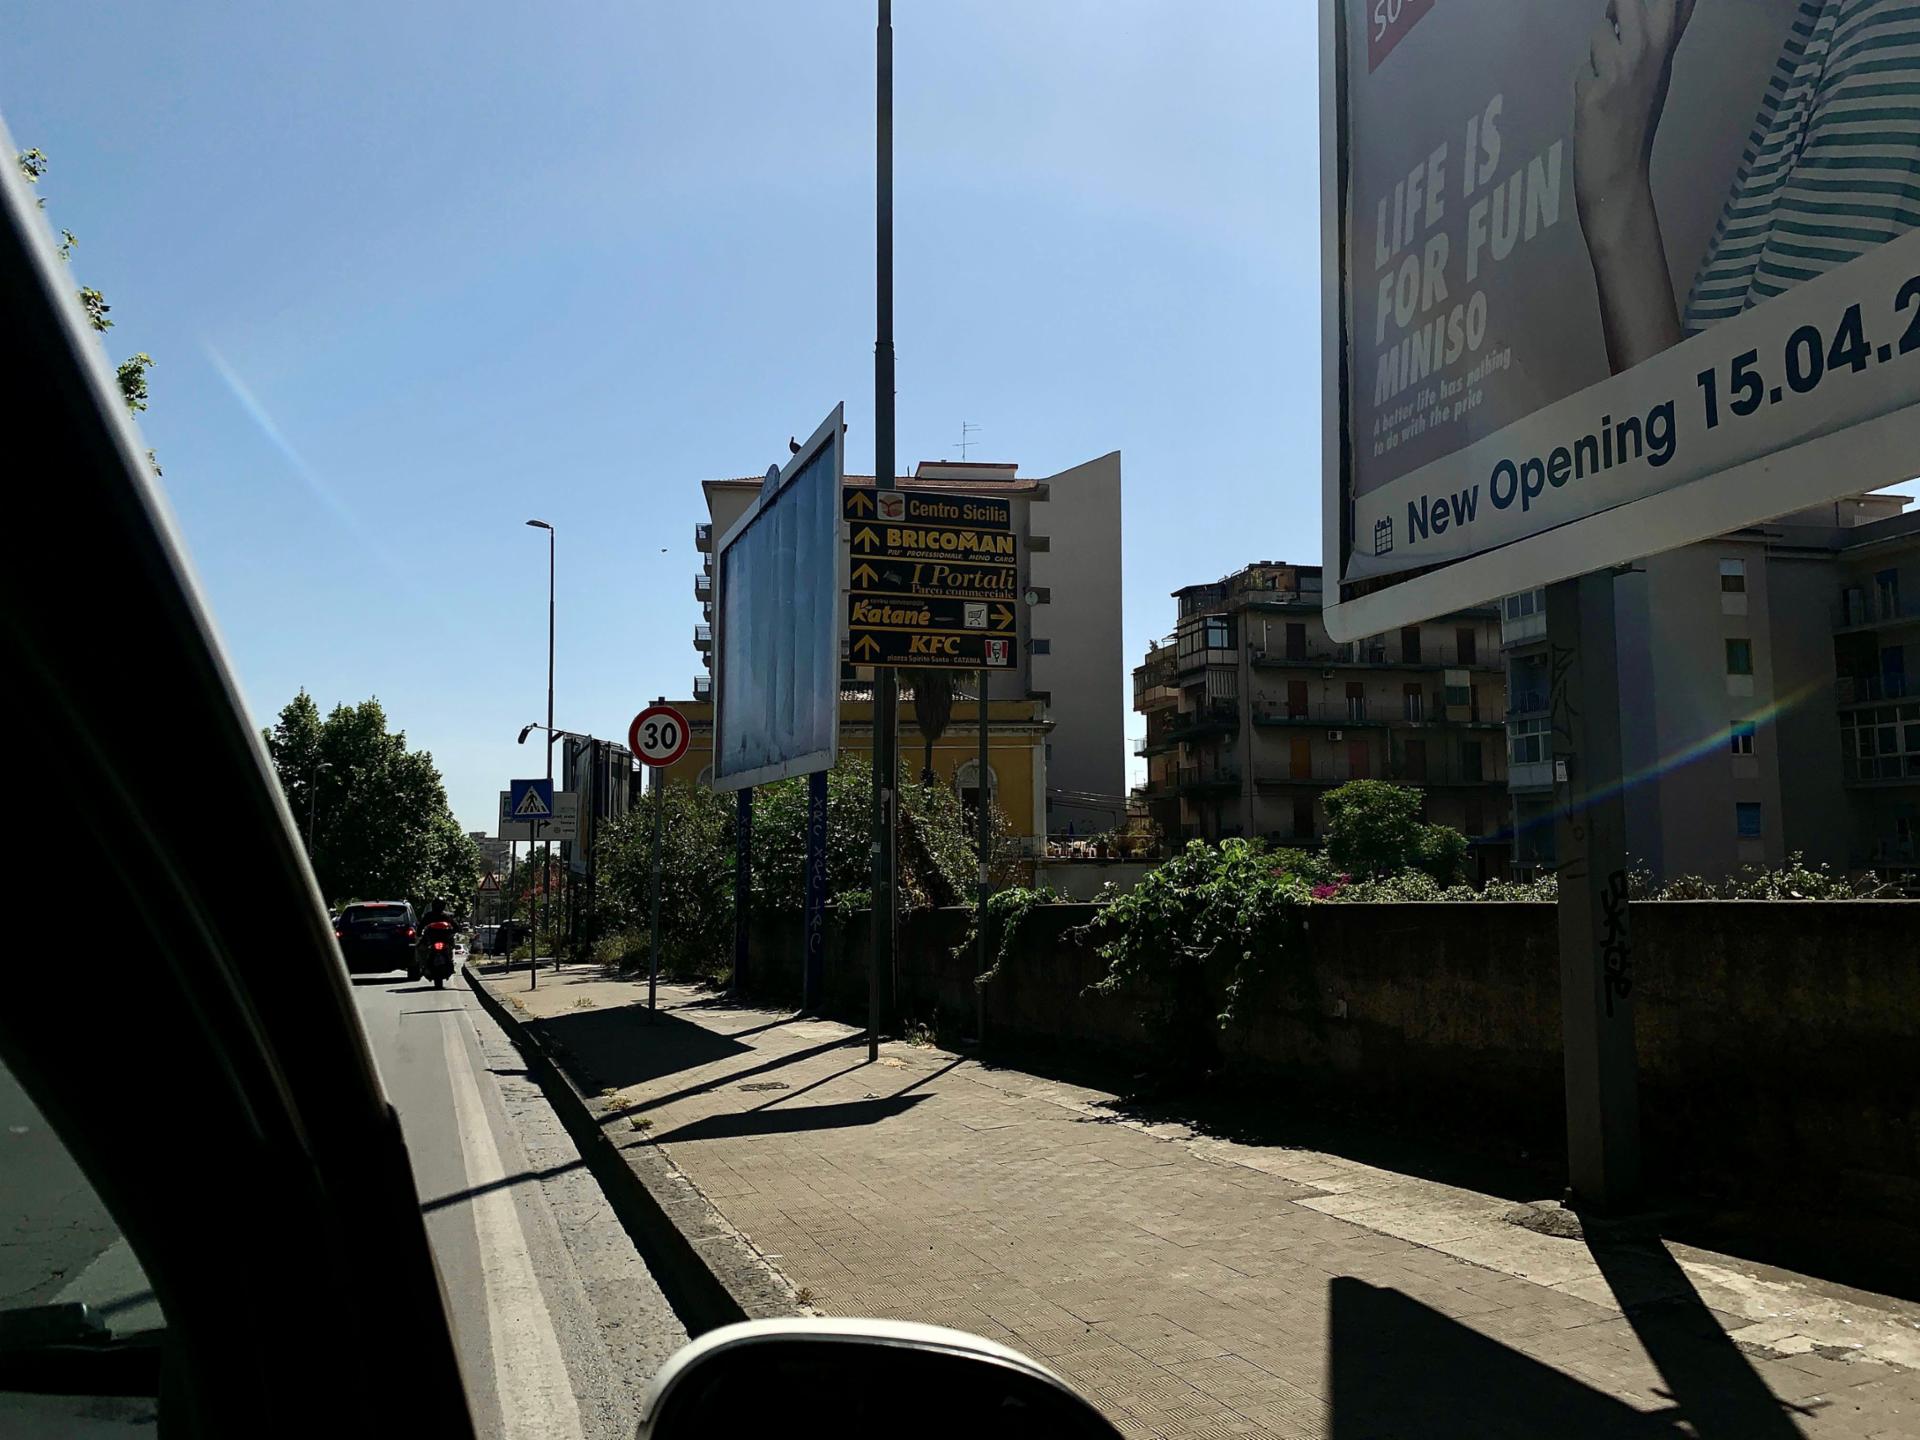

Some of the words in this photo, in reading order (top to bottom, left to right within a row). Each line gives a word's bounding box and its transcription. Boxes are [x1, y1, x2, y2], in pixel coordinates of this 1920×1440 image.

[1374, 141, 1448, 270] LIFE
[1463, 94, 1503, 199] IS
[1374, 232, 1449, 346] FOR
[1466, 138, 1566, 282] FUN
[1373, 290, 1487, 409] MINISO
[1373, 417, 1380, 438] A
[1382, 403, 1414, 432] better
[1416, 387, 1437, 412] life
[1440, 377, 1464, 400] has
[1466, 346, 1512, 388] nothing
[1373, 440, 1384, 457] to
[1386, 431, 1399, 450] do
[1401, 414, 1426, 443] with
[1429, 405, 1450, 428] the
[1453, 389, 1483, 423] price
[1407, 483, 1479, 544] New
[1490, 399, 1675, 513] Opening
[909, 500, 959, 519] Centro
[963, 503, 1008, 522] Sicilia
[886, 528, 1014, 555] BRICOMAN
[968, 553, 991, 562] MENO
[994, 555, 1015, 563] CARO
[910, 563, 923, 585] I
[929, 565, 1016, 590] Portali
[911, 584, 943, 596] Parco
[945, 587, 1014, 599] commerciale
[851, 599, 931, 626] Katané
[908, 635, 961, 654] KFC
[644, 722, 677, 750] 30
